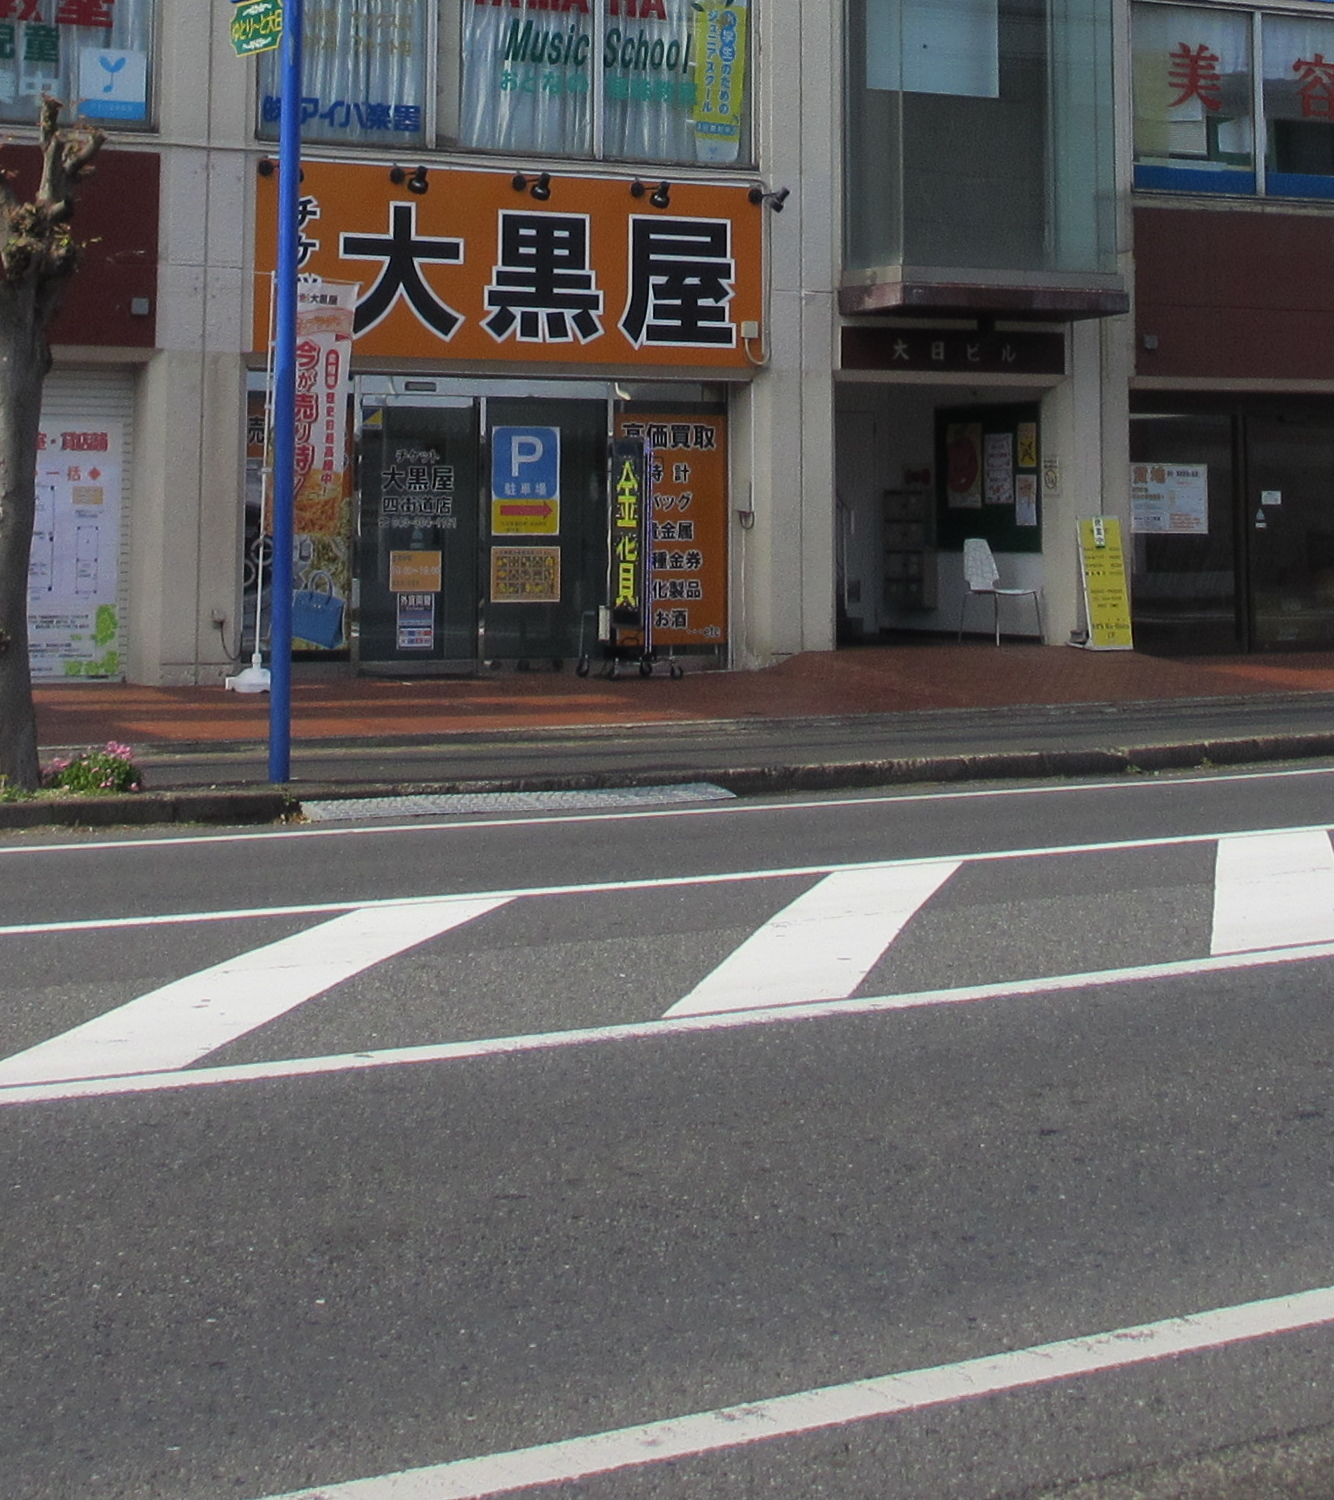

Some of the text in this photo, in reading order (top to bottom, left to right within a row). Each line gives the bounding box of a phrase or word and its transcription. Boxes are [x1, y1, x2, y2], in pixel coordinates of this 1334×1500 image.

[504, 18, 692, 74] Music School
[339, 201, 737, 350] 大黒屋
[893, 338, 1017, 363] 大日ビル
[623, 423, 715, 449] 高価買取
[511, 435, 544, 477] P
[382, 466, 454, 492] 大黒屋
[505, 483, 547, 496] 駐車場
[383, 495, 452, 515] 四街道店
[654, 609, 688, 629] お酒
